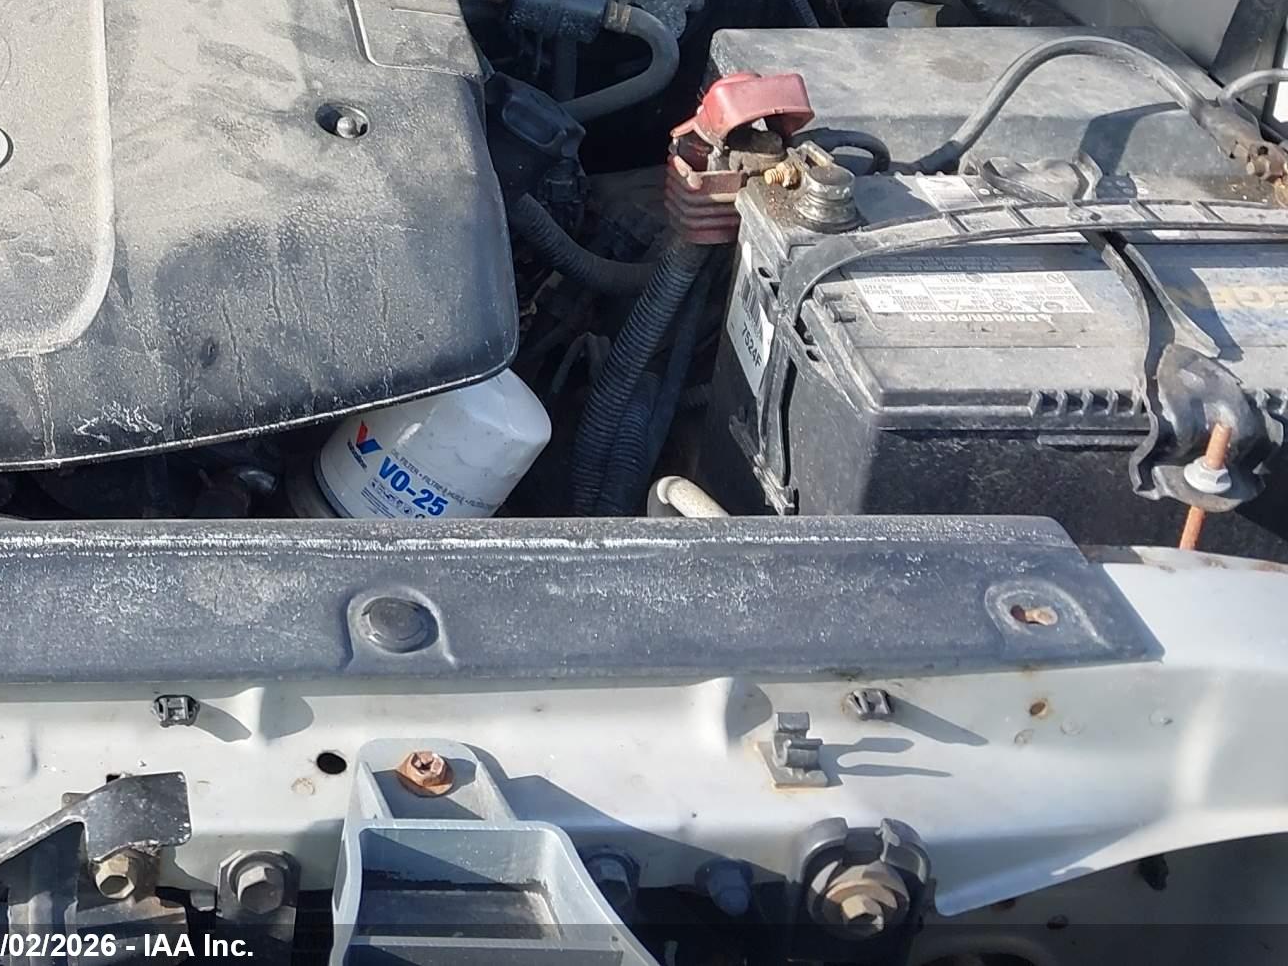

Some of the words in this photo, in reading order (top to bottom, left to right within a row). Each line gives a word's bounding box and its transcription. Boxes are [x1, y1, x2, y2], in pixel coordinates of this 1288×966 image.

[742, 321, 762, 367] 7524F
[378, 455, 448, 516] VO-25
[399, 456, 419, 475] FILTER
